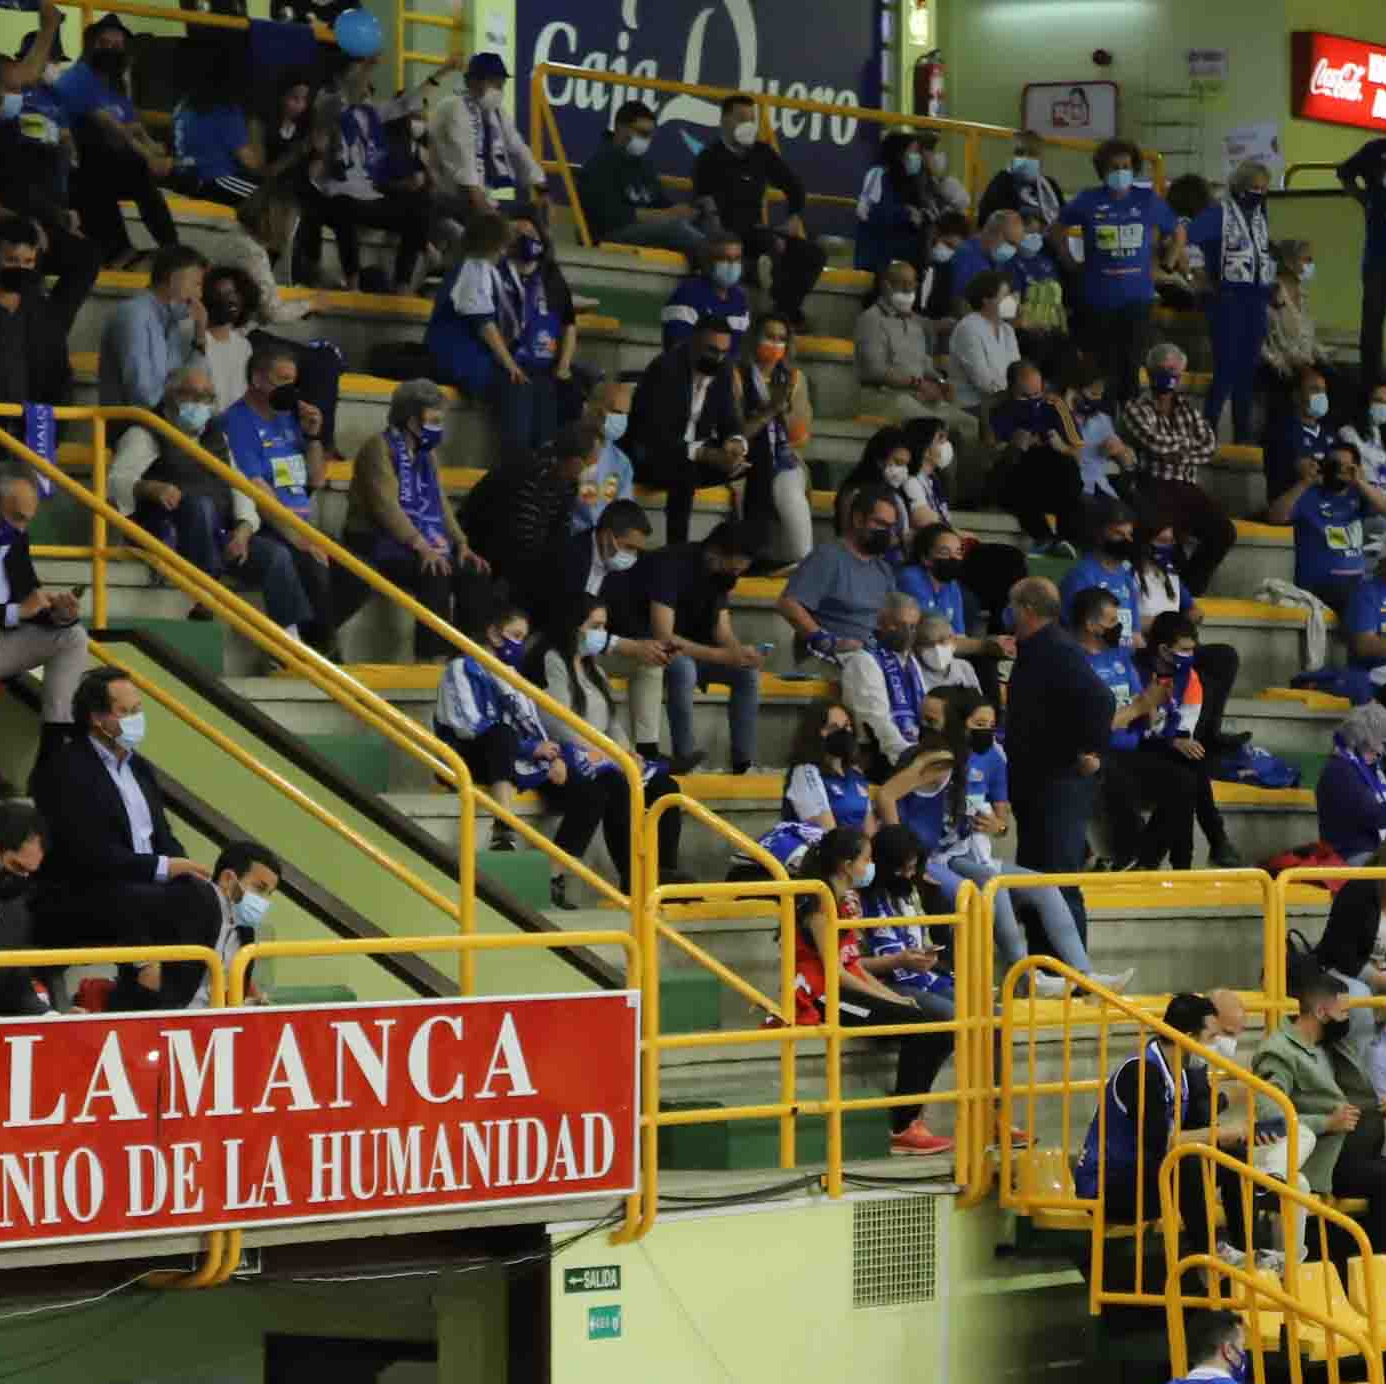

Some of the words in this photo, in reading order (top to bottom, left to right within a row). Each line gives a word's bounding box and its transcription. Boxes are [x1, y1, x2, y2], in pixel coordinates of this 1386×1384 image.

[124, 1142, 205, 1218] DE
[223, 1135, 292, 1211] LA
[307, 1112, 616, 1204] HUMANIDAD
[584, 1269, 618, 1289] SALIDA
